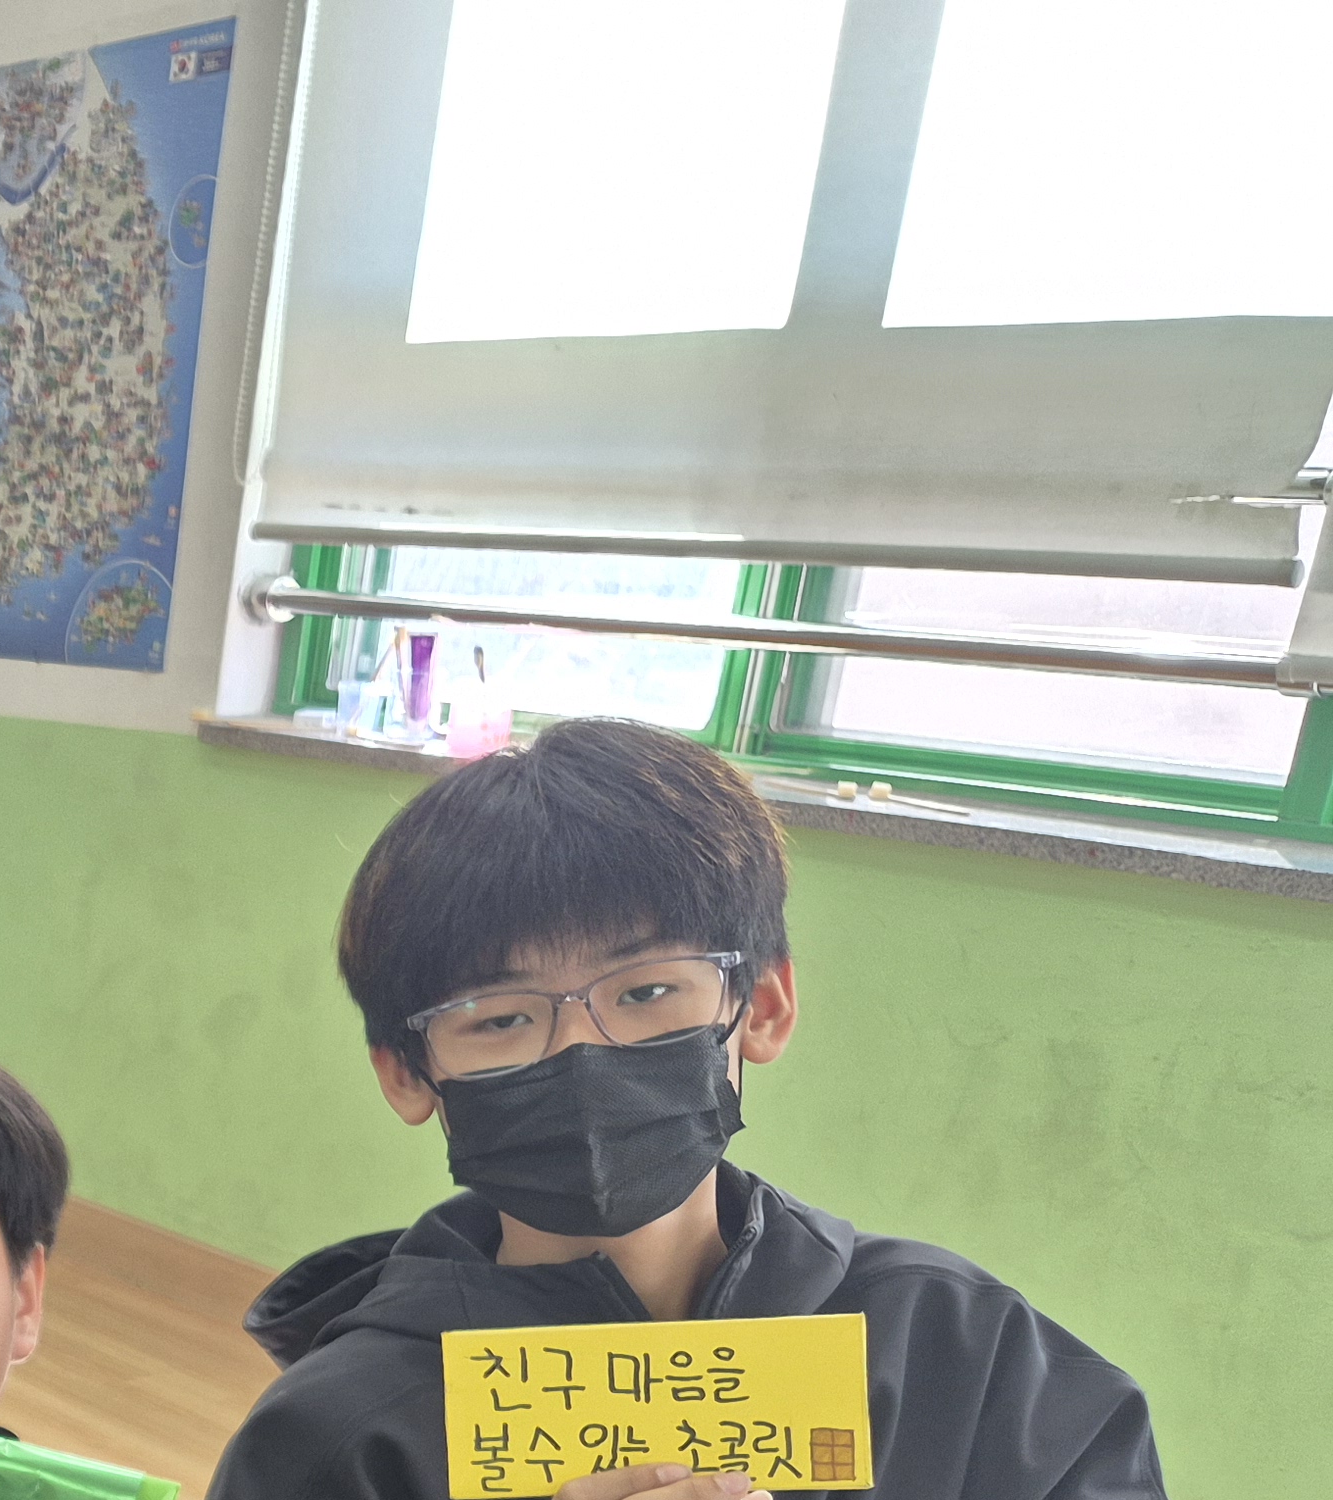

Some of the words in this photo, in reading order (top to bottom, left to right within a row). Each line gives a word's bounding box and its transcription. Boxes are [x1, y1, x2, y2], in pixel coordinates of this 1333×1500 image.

[467, 1346, 586, 1411] 친구
[607, 1346, 750, 1404] 마음을
[676, 1419, 802, 1482] 초콜릿
